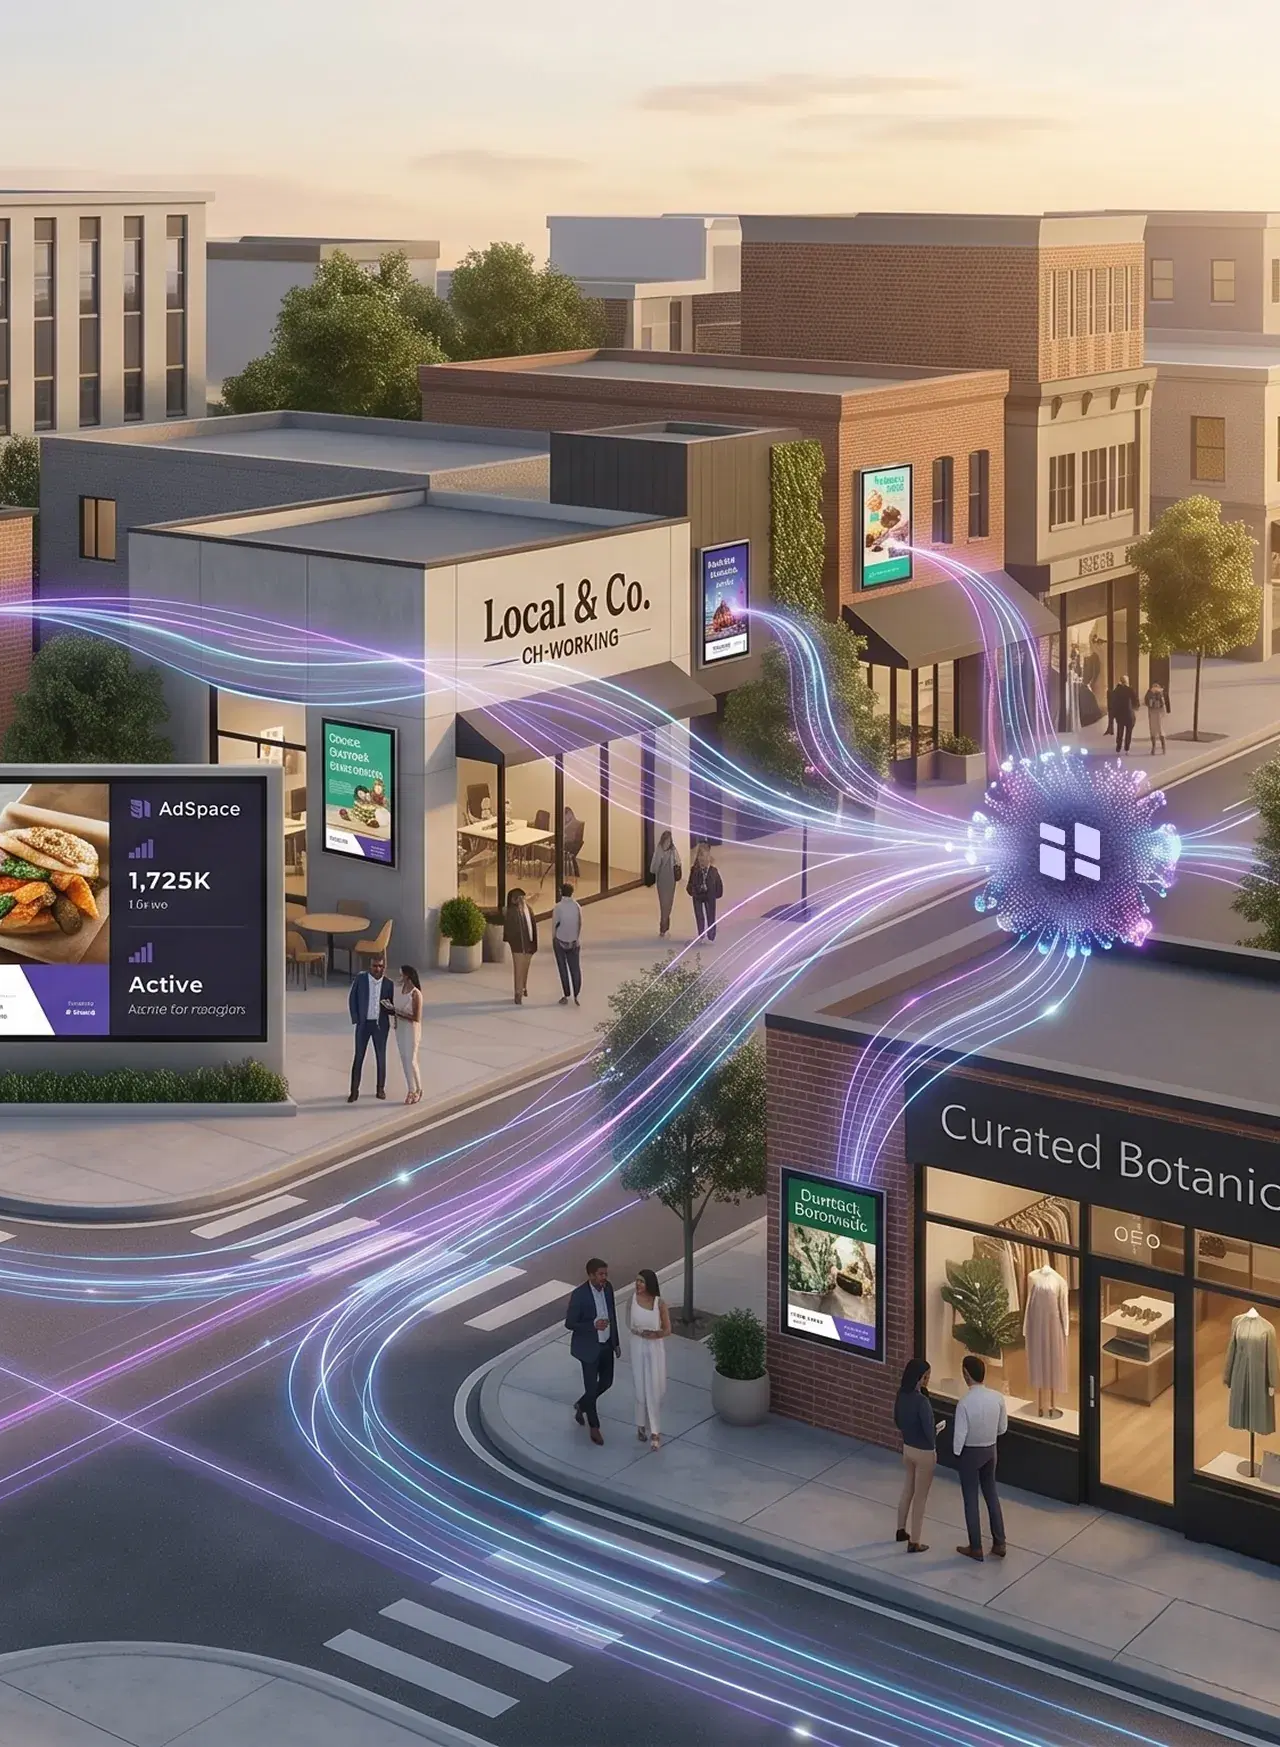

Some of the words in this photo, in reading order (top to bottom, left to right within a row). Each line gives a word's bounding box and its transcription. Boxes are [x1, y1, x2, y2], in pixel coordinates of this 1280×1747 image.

[483, 582, 566, 643] Local
[574, 578, 598, 624] &
[606, 572, 651, 617] Co.
[522, 628, 619, 665] CH-WORKING
[158, 801, 241, 819] AdSpace
[128, 871, 211, 893] 1,725K
[128, 974, 204, 994] Active
[940, 1103, 1102, 1171] Curated
[1119, 1140, 1280, 1212] Botanic
